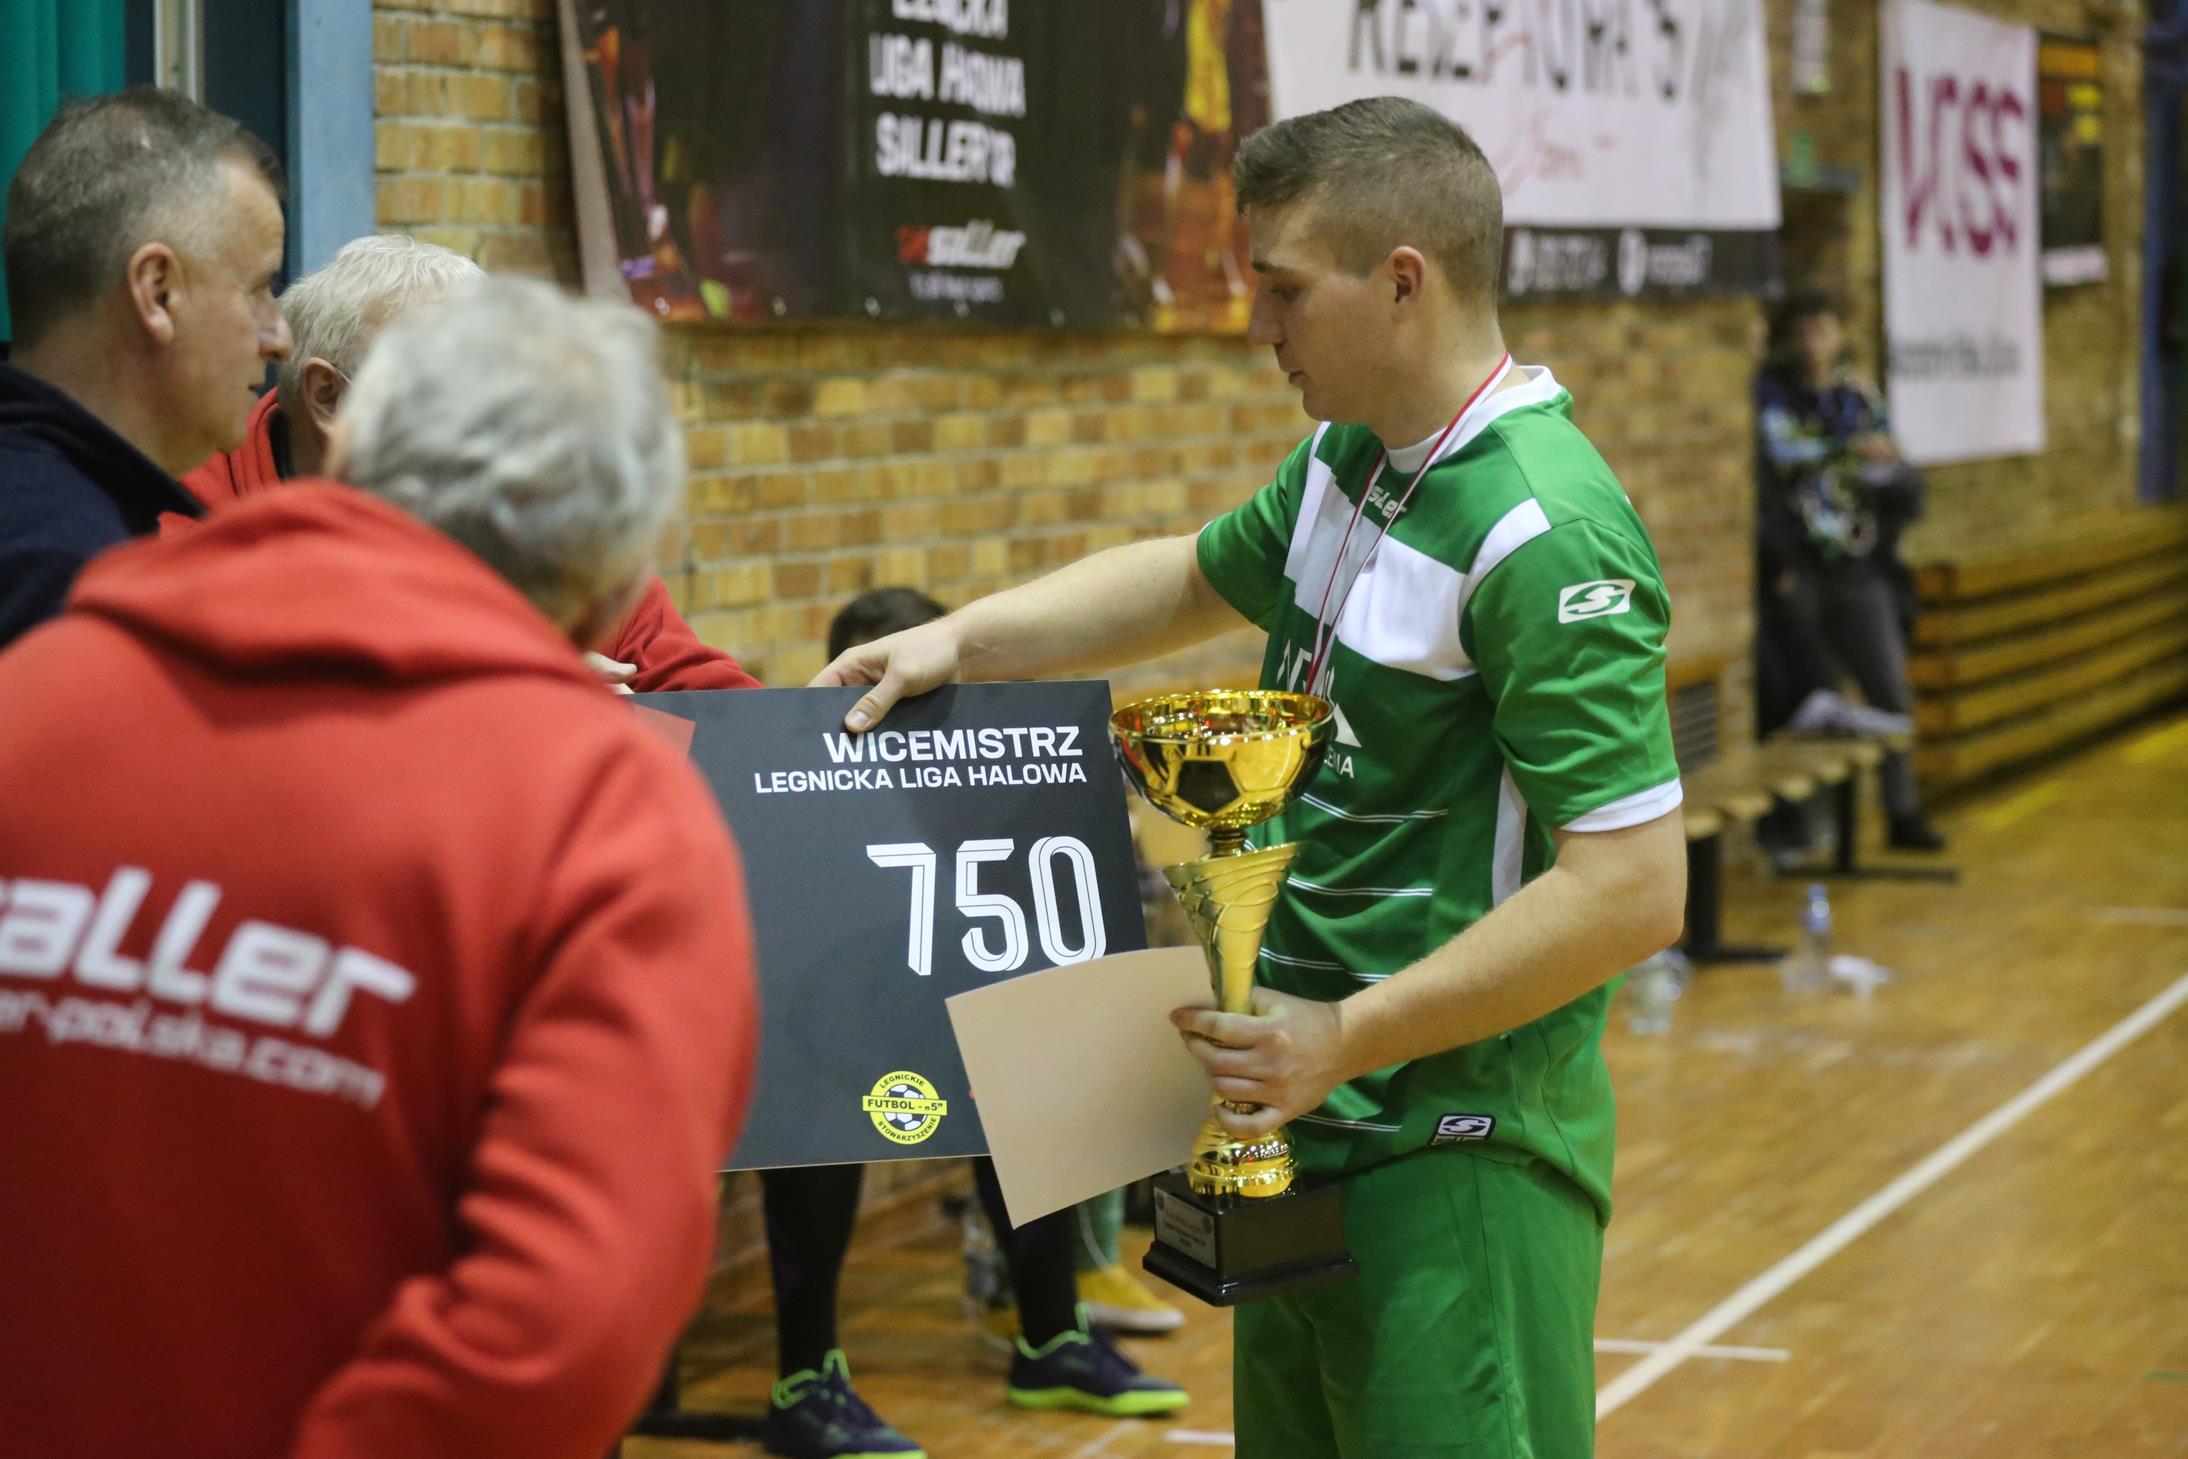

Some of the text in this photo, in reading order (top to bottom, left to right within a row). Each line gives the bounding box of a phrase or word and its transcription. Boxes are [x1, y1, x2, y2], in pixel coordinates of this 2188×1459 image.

[823, 726, 1083, 764] WICEMISTRZ
[754, 763, 1087, 794] LEGNICKA LIGA HALOWA
[866, 835, 1107, 976] 750
[0, 864, 417, 1040] aller
[879, 1074, 925, 1089] LEGNICKIE
[867, 1098, 915, 1110] FUTBOL
[878, 1116, 938, 1142] STOWARZYSZENIE
